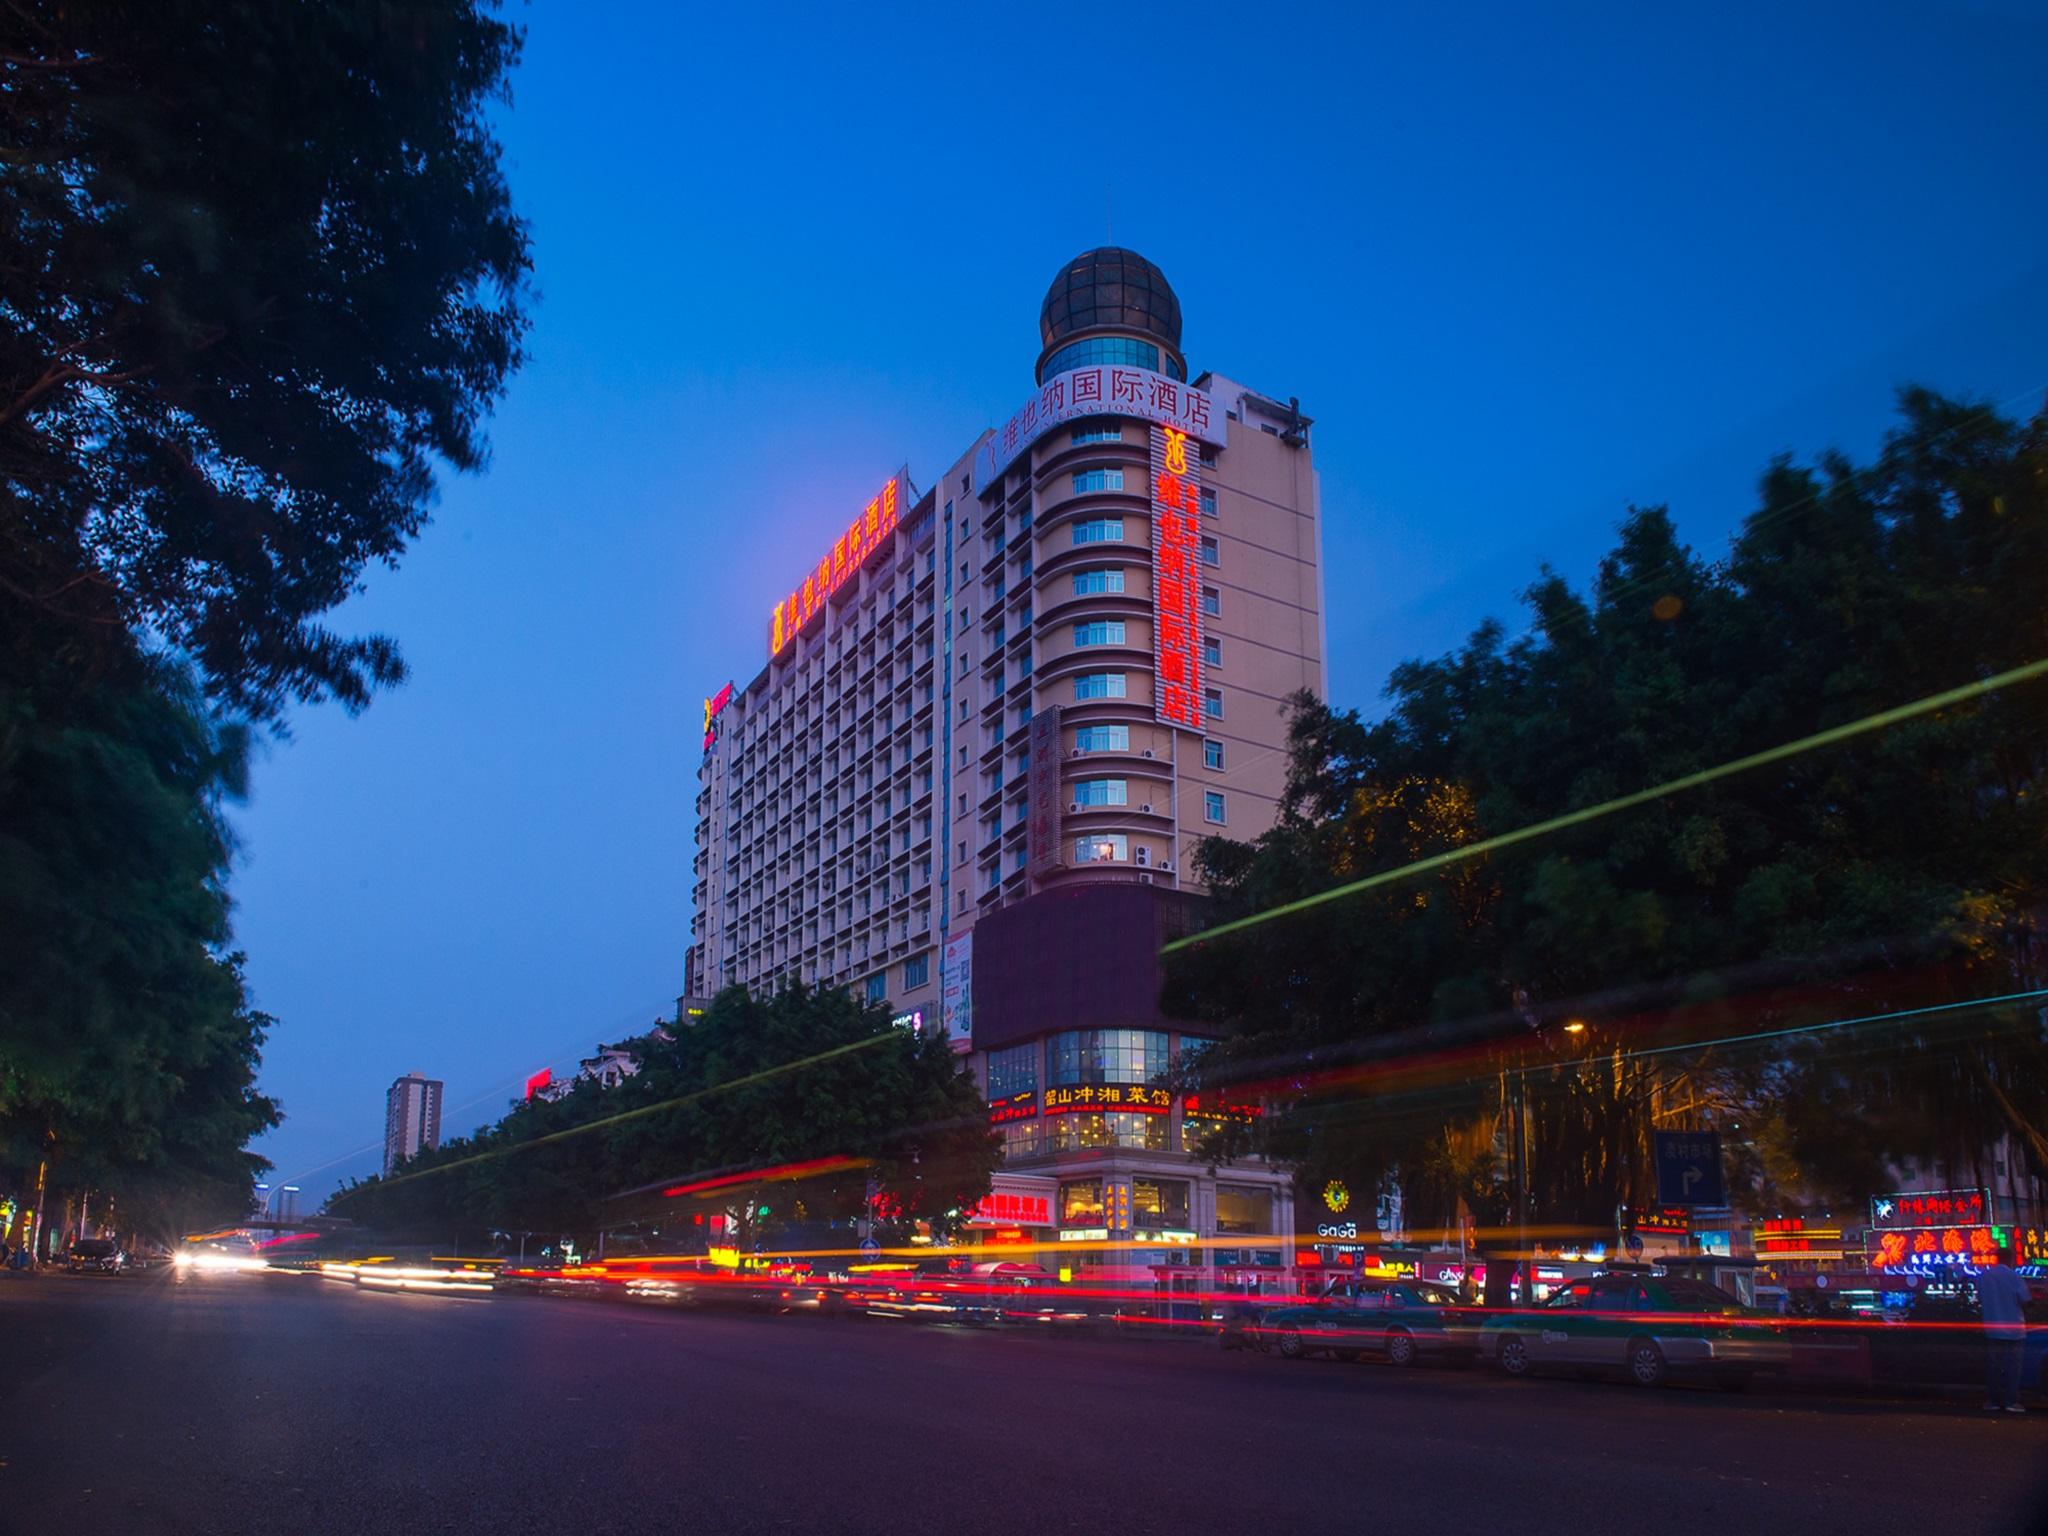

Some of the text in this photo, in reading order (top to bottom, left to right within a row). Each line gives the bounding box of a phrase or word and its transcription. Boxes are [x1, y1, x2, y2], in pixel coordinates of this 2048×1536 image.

[1002, 368, 1211, 452] 维也纳国际酒店
[1162, 417, 1208, 438] HOTEL
[786, 478, 897, 626] 维也纳国际酒店
[1155, 471, 1189, 725] 维也纳国际酒店
[1044, 1086, 1171, 1106] 韶山冲湘菜馆
